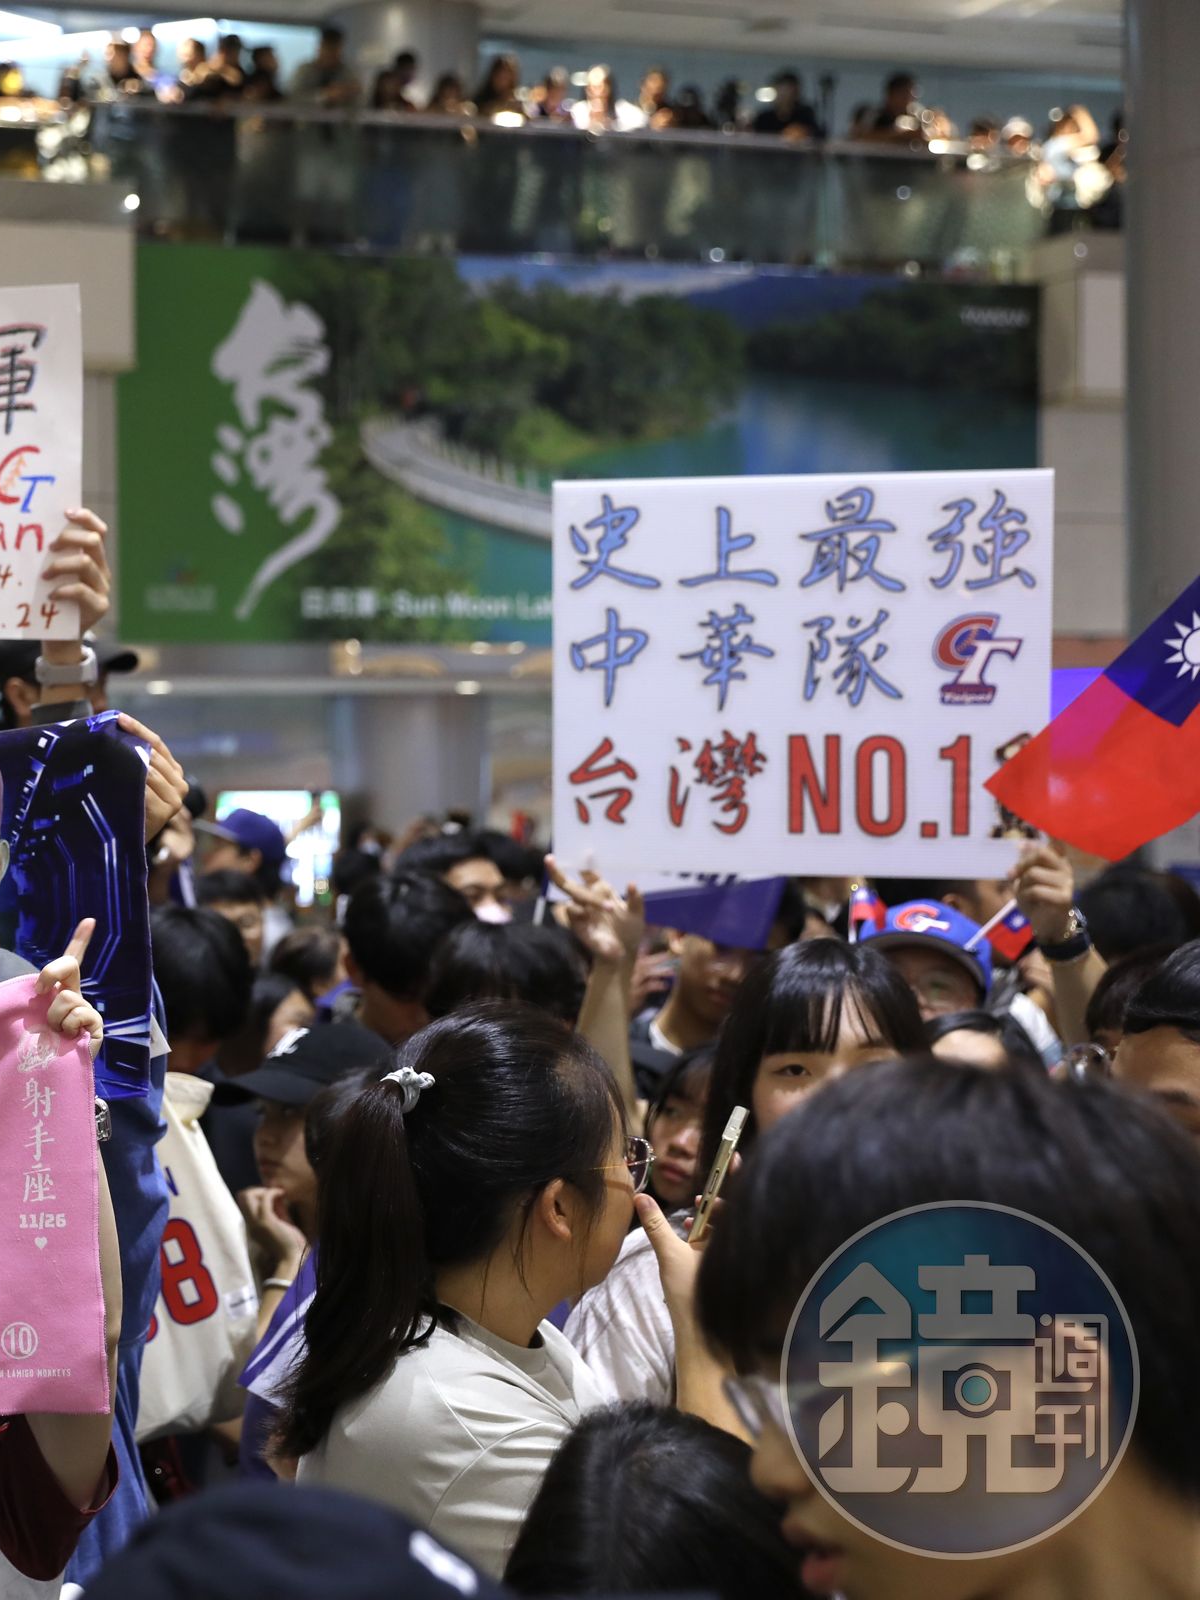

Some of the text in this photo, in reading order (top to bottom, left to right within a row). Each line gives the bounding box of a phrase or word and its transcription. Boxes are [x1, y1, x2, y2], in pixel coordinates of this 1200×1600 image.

[570, 486, 1038, 593] 史上最強
[570, 603, 903, 711] 中華隊
[569, 730, 972, 839] 台灣 NO.1
[22, 1077, 57, 1203] 射手座
[19, 1212, 67, 1229] 11/26
[6, 1326, 32, 1355] 10
[7, 1368, 34, 1378] LAMIGO
